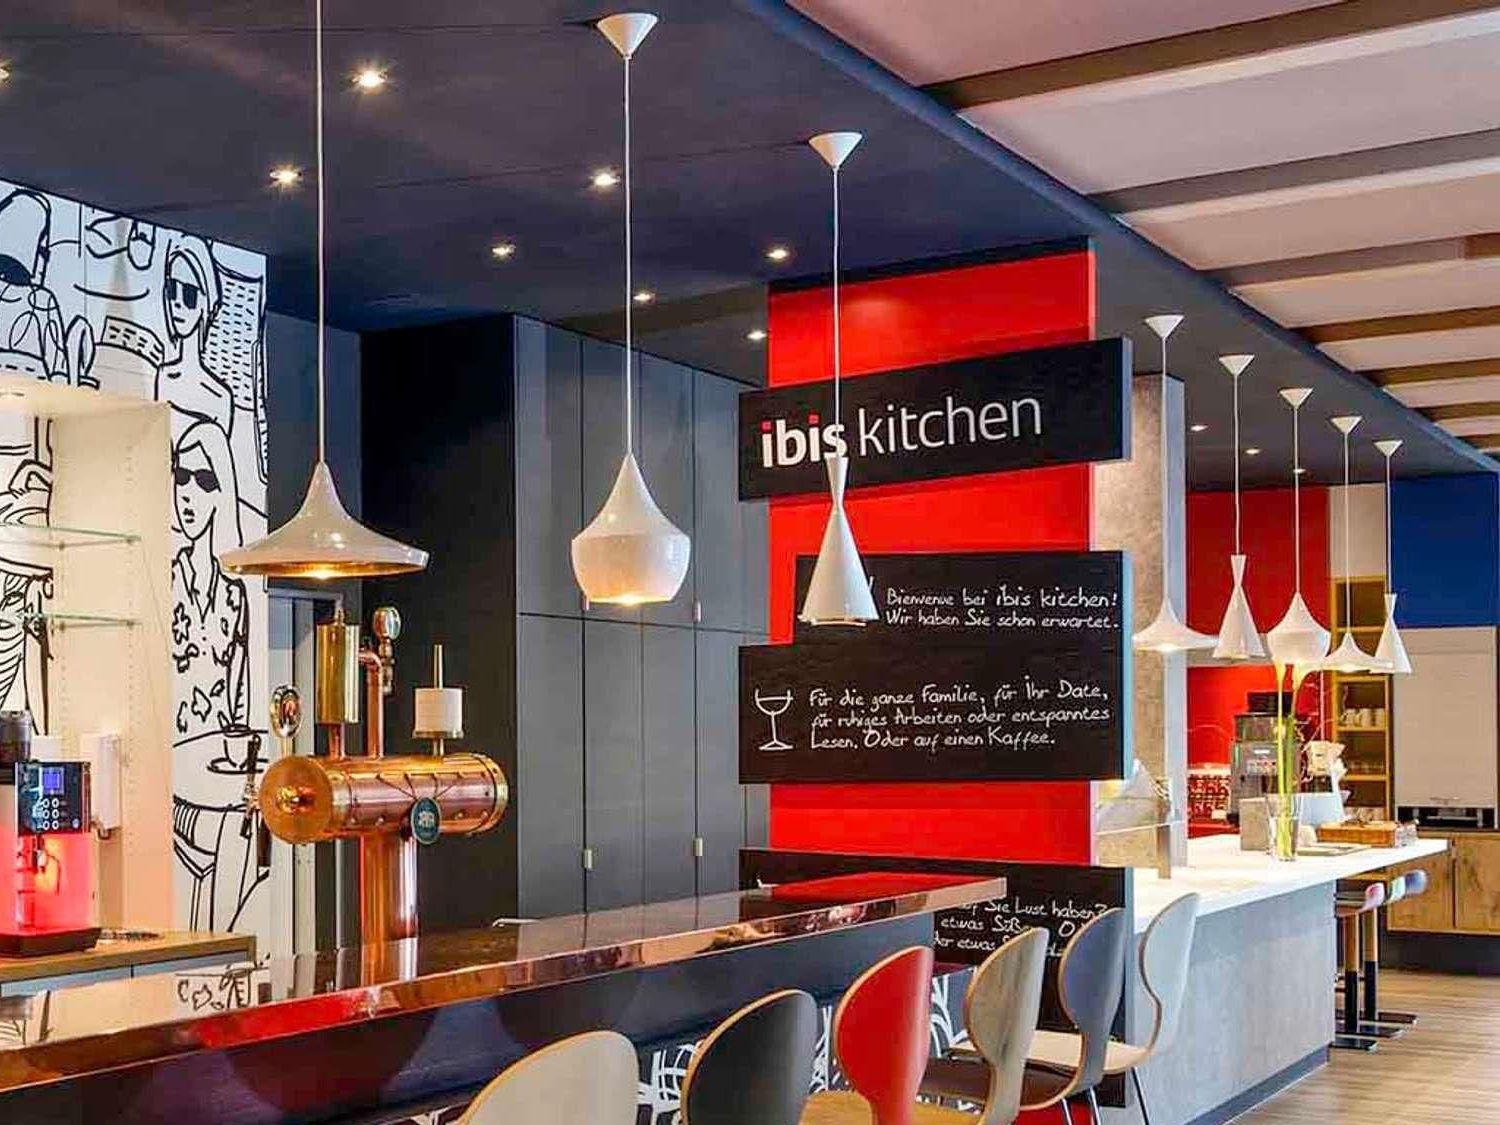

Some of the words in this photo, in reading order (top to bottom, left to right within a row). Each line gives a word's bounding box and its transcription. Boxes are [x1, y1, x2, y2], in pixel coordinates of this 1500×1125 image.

[761, 412, 849, 468] ibis
[857, 396, 1042, 457] kitchen
[886, 587, 954, 606] Bienvenue
[962, 588, 988, 606] bei
[1040, 587, 1117, 607] kitchen!
[886, 608, 912, 625] Wir
[918, 608, 960, 625] haben
[964, 608, 990, 626] Sie
[997, 611, 1036, 627] schon
[1041, 615, 1119, 628] erwartet.
[809, 689, 832, 707] Für
[839, 690, 864, 706] die
[870, 691, 914, 712] ganze
[922, 684, 986, 704] Familie,
[994, 685, 1018, 707] für
[1057, 679, 1108, 700] Date,
[811, 713, 832, 728] für
[894, 707, 962, 725] Arbeiten
[967, 704, 1006, 724] oder
[1012, 708, 1110, 727] entspanntes
[811, 724, 858, 749] Lesen.
[914, 734, 939, 753] auf
[944, 728, 984, 746] einen
[988, 725, 1056, 751] Kaffee.
